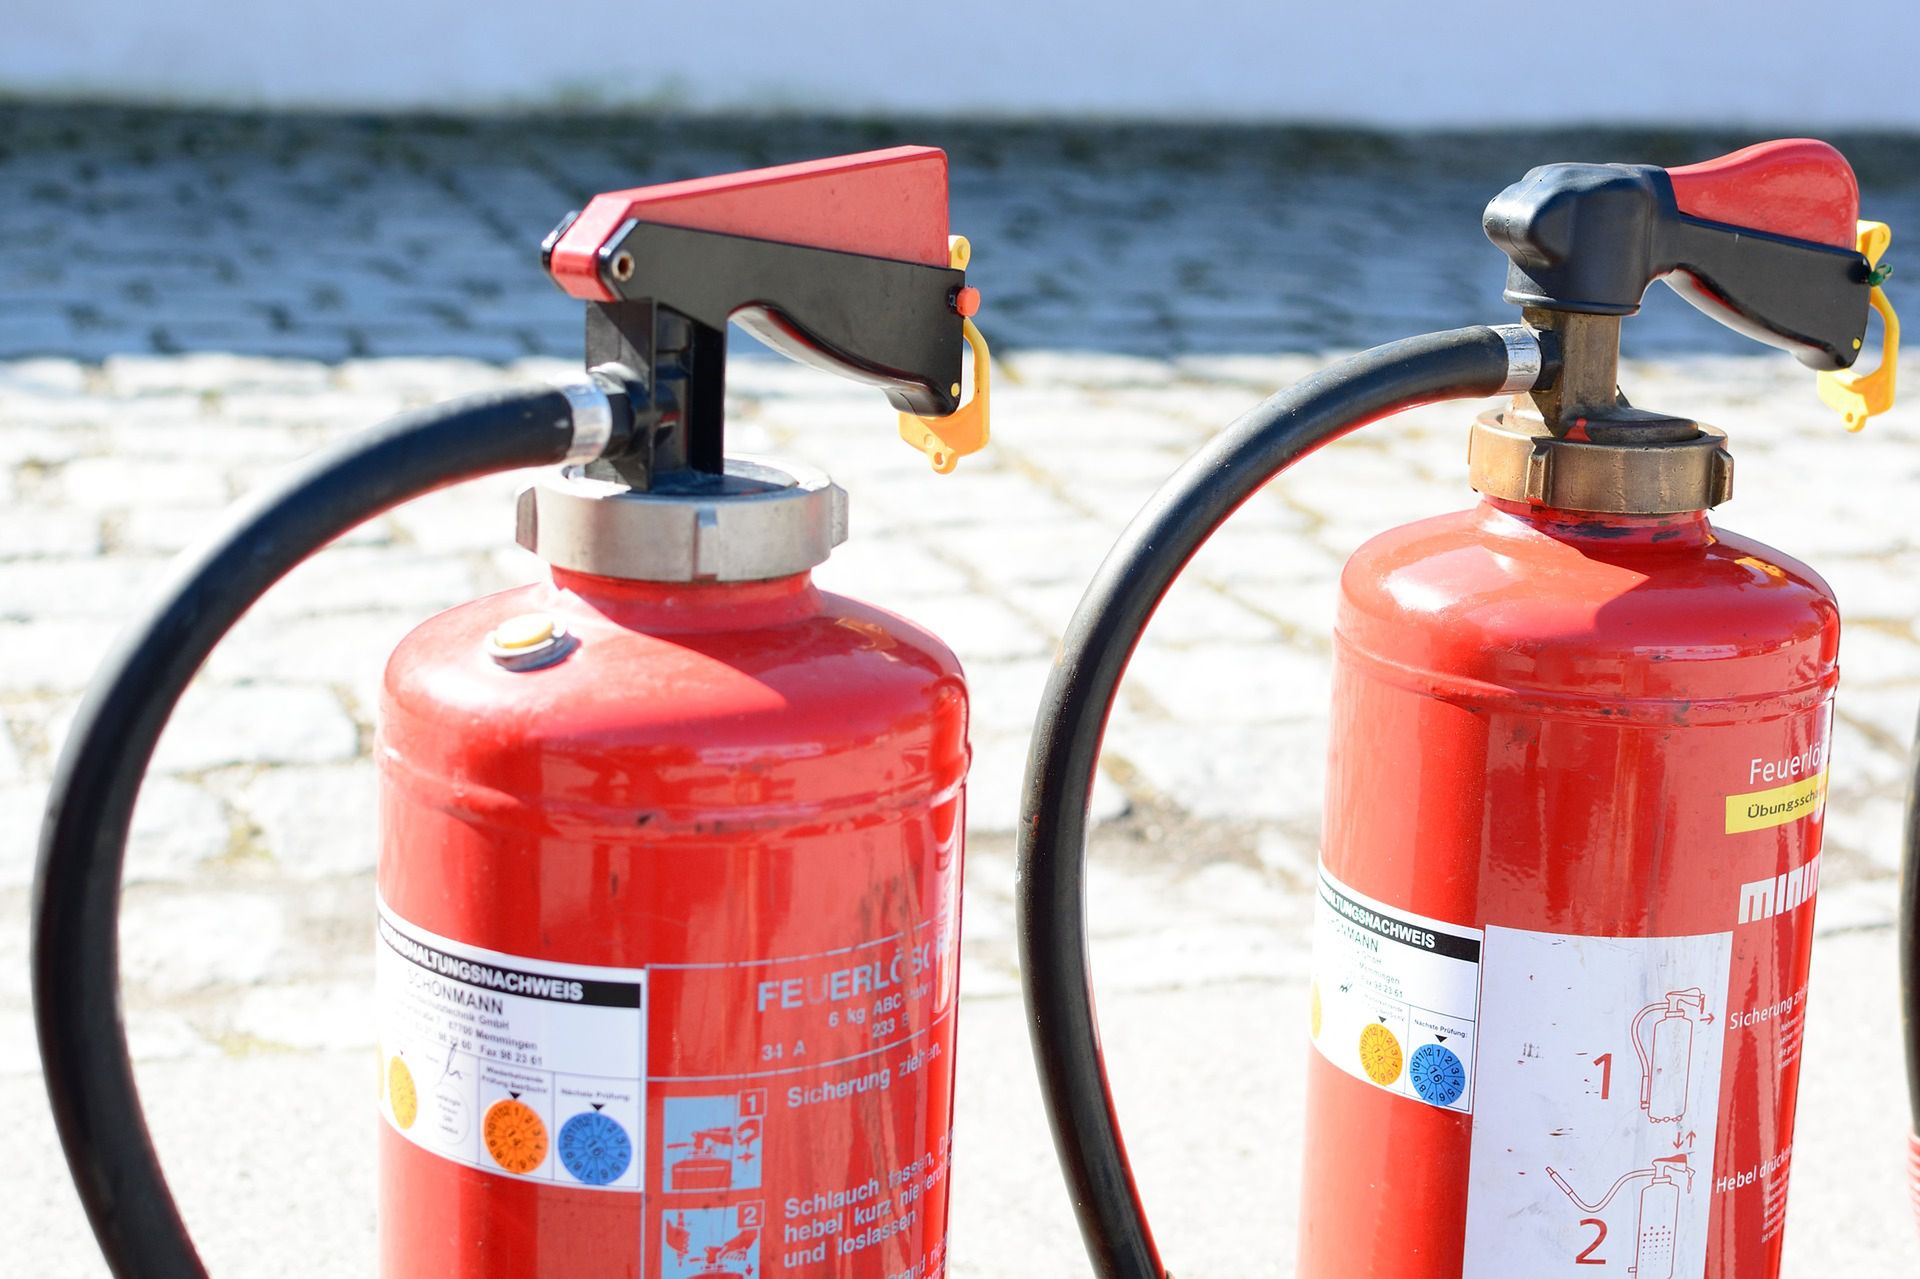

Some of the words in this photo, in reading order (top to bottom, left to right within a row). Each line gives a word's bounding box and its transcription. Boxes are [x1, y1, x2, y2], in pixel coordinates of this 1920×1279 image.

[1749, 742, 1824, 785] Feuerlö
[829, 1012, 839, 1027] 6
[847, 1008, 865, 1025] kg
[1729, 996, 1793, 1030] Sicherung
[475, 1027, 537, 1050] Memmingen
[481, 1044, 497, 1057] Fax
[761, 1044, 783, 1061] 34
[793, 1040, 806, 1056] A
[872, 1018, 896, 1039] 233
[787, 1068, 891, 1109] Sicherung
[1430, 1067, 1442, 1082] 16
[1593, 1053, 1613, 1100] 1
[748, 1093, 757, 1113] 1
[1716, 1165, 1757, 1193] Hebel
[743, 1207, 757, 1225] 2
[784, 1178, 880, 1219] Schlauch
[784, 1212, 843, 1244] hebel
[853, 1199, 892, 1227] kurz
[784, 1242, 826, 1268] und
[838, 1209, 917, 1256] loslassen
[1575, 1218, 1607, 1265] 2
